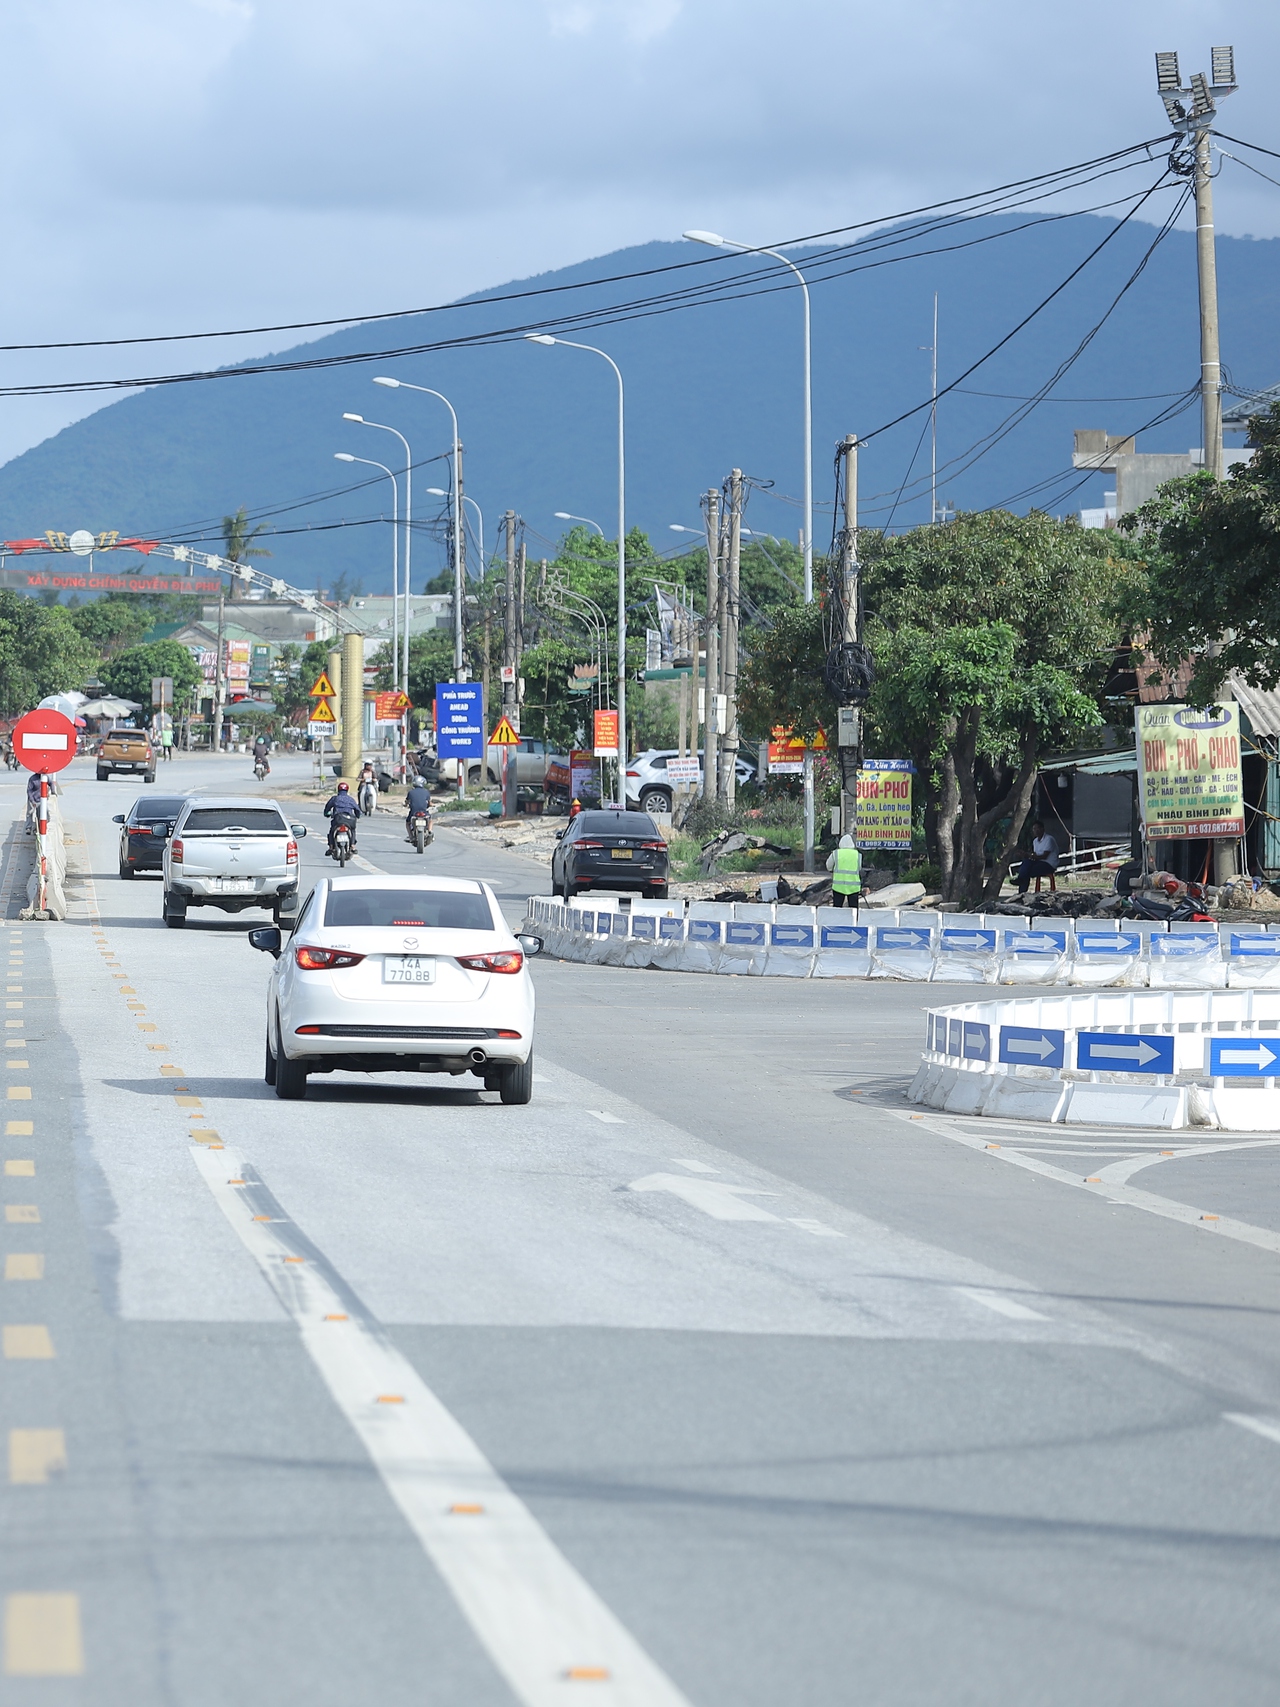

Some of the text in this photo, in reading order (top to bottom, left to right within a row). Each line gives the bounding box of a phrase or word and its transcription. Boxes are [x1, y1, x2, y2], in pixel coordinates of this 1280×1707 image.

[27, 573, 50, 585] XÂY
[52, 576, 86, 589] DỰNG
[89, 576, 126, 588] CHÍNH
[129, 577, 168, 591] QUYỀN
[1144, 710, 1170, 726] Quán
[314, 725, 332, 733] 300m
[441, 726, 457, 734] CÔNG
[1144, 730, 1238, 772] BÚN PHỞ CHÁO
[898, 803, 910, 811] heo
[1157, 808, 1232, 820] NHẬU BÌNH DÂN
[875, 829, 893, 838] BÌNH
[895, 829, 910, 838] DÂN
[401, 959, 421, 969] 14A
[391, 970, 430, 981] 770.88
